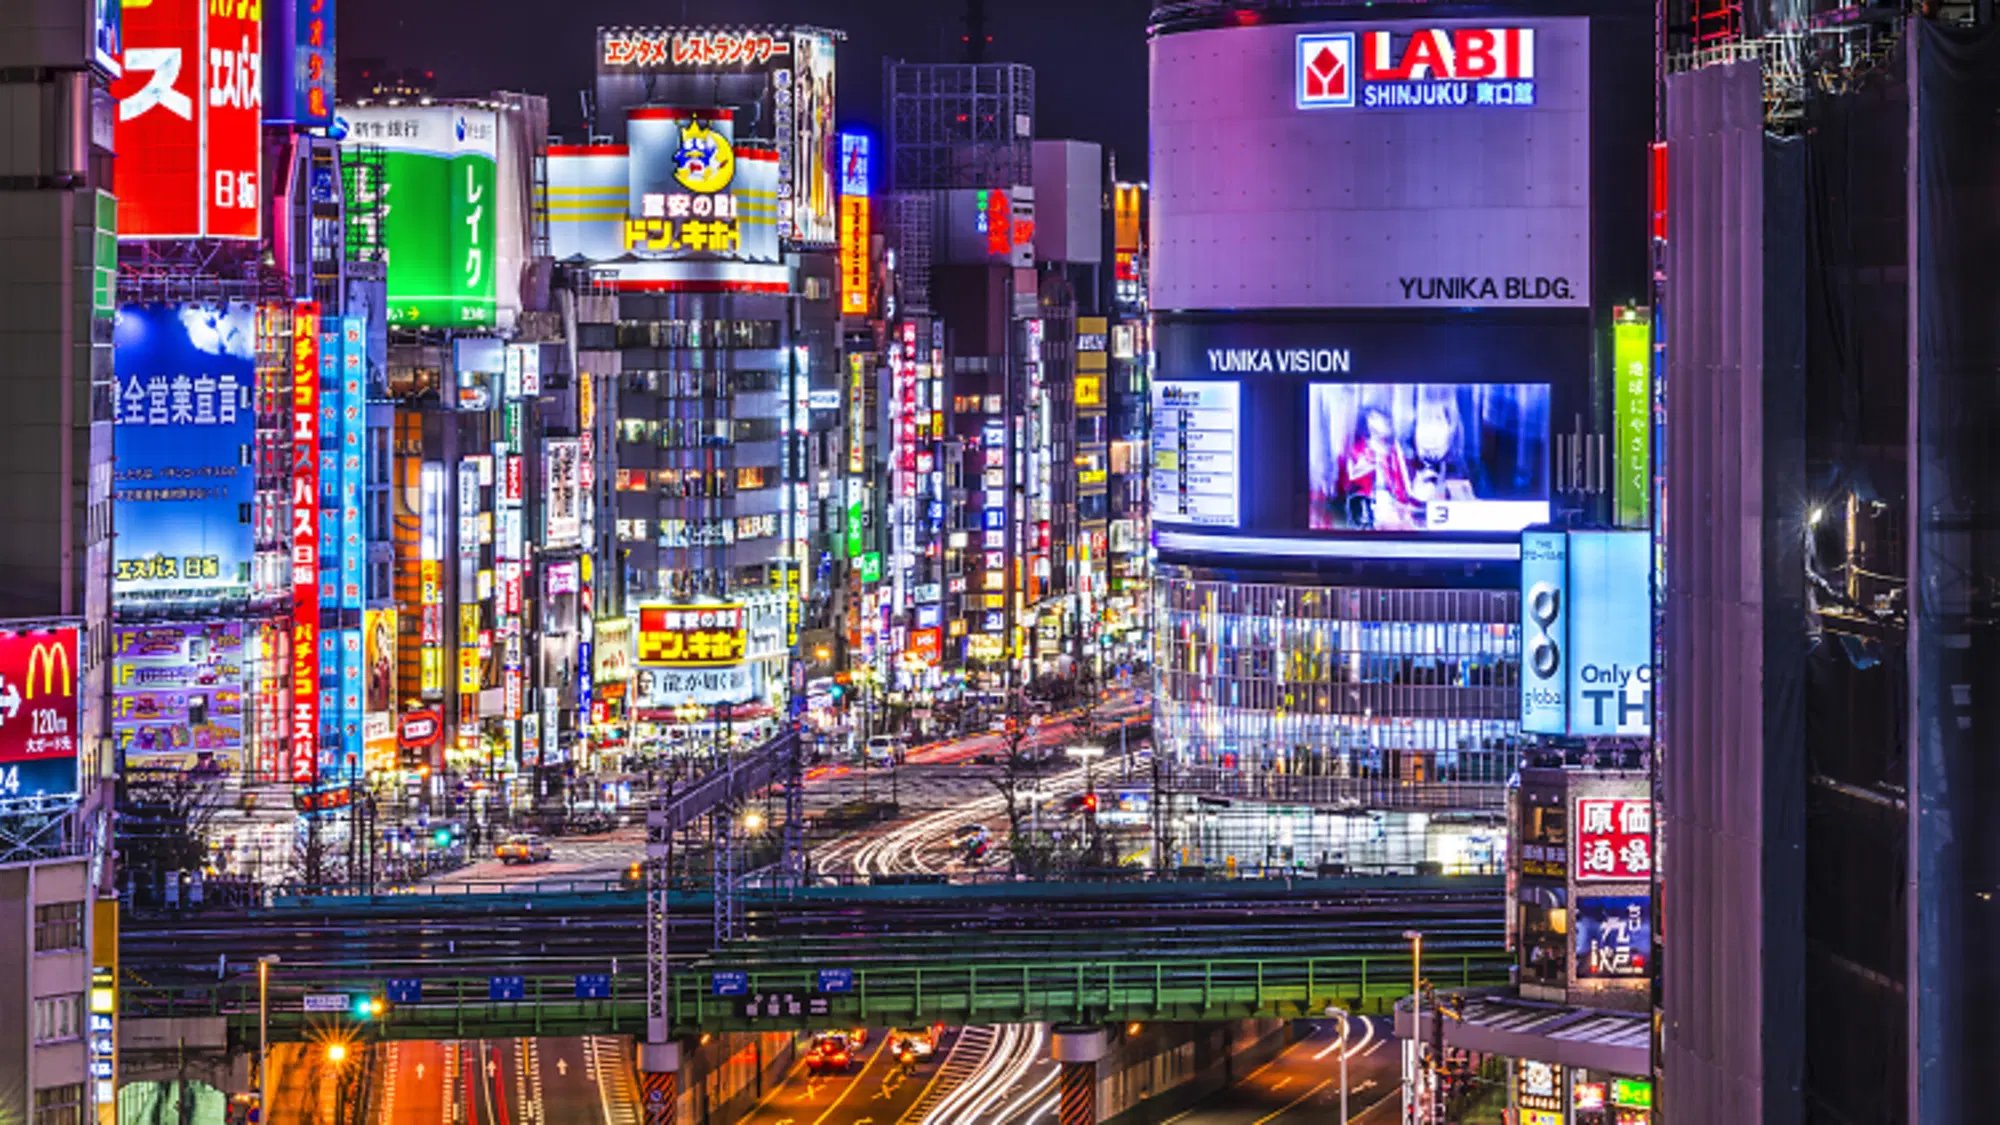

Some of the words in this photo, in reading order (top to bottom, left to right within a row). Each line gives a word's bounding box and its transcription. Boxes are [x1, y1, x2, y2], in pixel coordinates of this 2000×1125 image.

[1363, 28, 1534, 80] LABI
[1364, 82, 1468, 107] SHINJUKU
[1476, 82, 1534, 106] 東口館
[466, 164, 483, 288] レイク
[1399, 276, 1498, 300] YUNIKA
[1505, 276, 1576, 300] BLDG.
[295, 315, 313, 406] パチンコ
[1207, 348, 1274, 373] YUNIKA
[1275, 348, 1350, 373] VISION
[294, 412, 313, 537] エスパス
[295, 623, 313, 695] パチンコ
[1581, 663, 1631, 689] Only
[1583, 802, 1651, 835] 原価
[1583, 838, 1651, 873] 酒場
